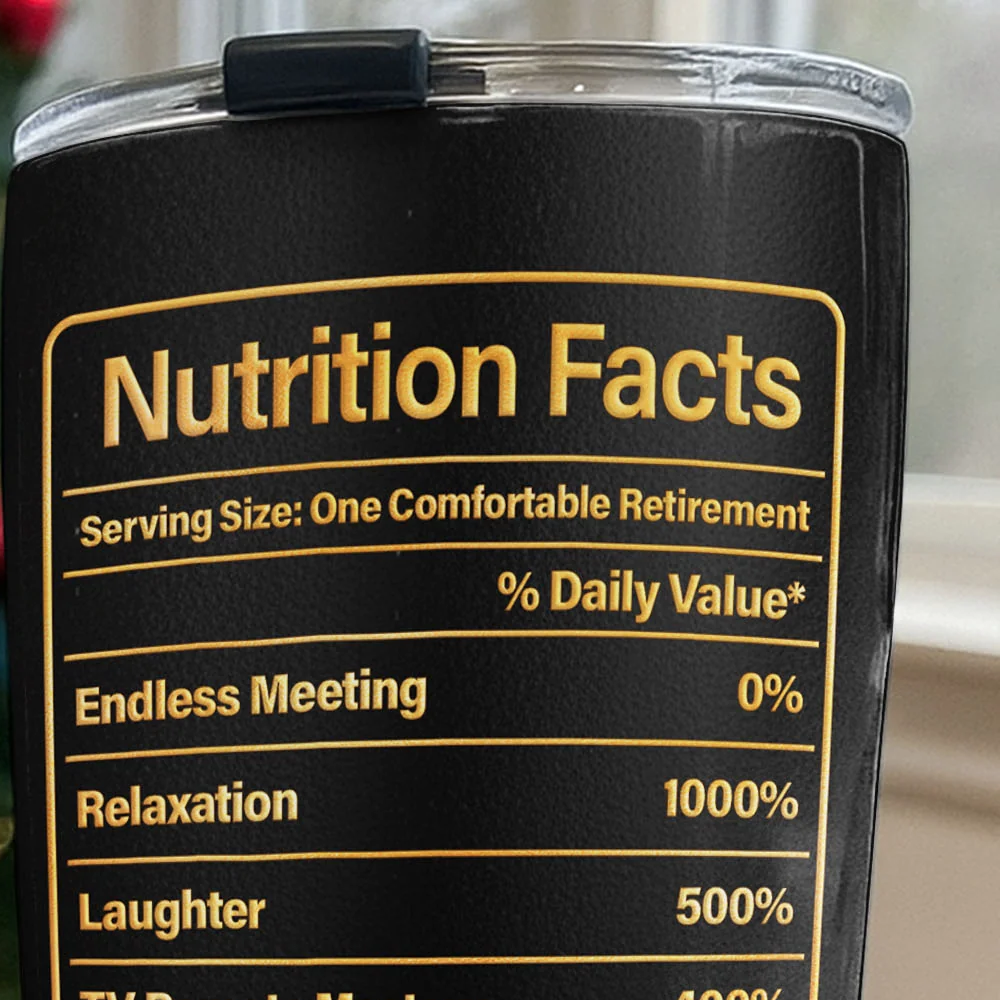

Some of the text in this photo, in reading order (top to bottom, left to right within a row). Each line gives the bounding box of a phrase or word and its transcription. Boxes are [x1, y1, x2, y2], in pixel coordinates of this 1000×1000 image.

[104, 321, 801, 447] Nutrition Facts
[81, 484, 810, 547] Serving Size: One Comfortable Retirement
[498, 572, 539, 610] %
[551, 570, 660, 623] Daily
[76, 668, 803, 725] Endless Meeting 0%
[78, 779, 798, 827] Relaxation 1000%
[80, 887, 793, 940] Laughter 500%
